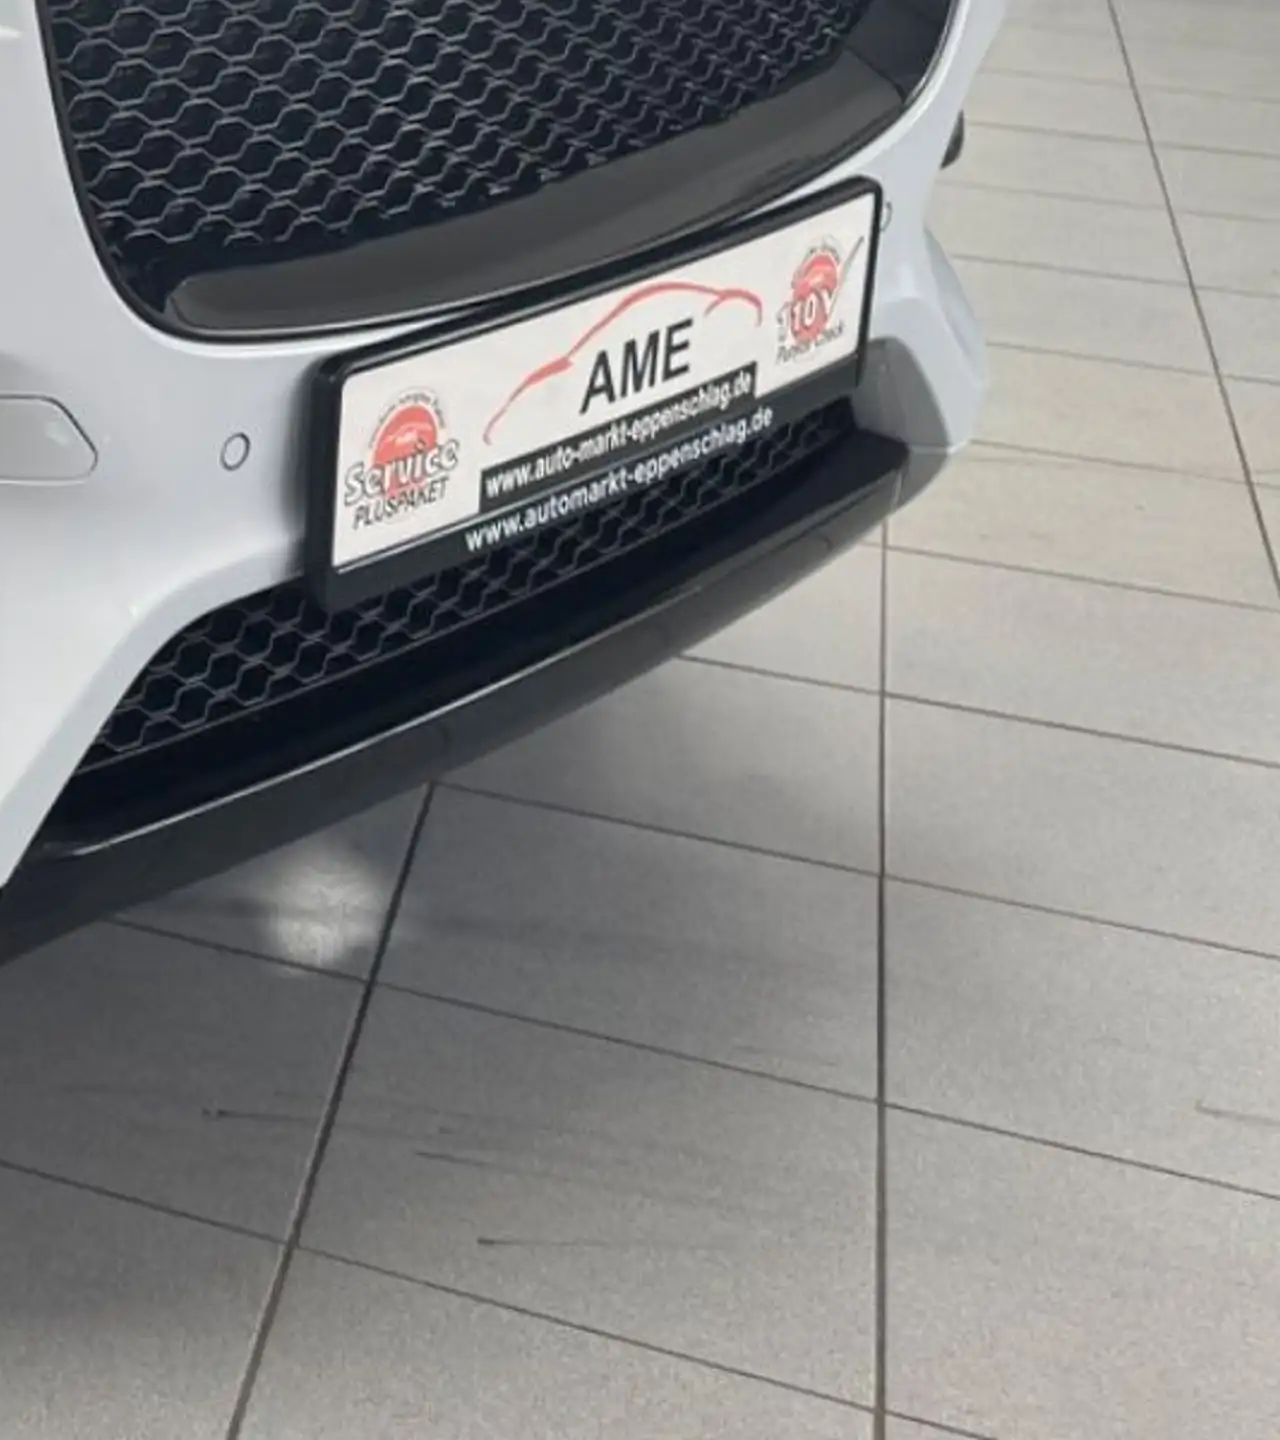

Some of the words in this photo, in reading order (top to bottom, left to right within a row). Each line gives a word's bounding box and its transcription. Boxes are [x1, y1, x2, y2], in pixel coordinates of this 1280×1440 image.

[579, 317, 694, 416] AME
[464, 405, 774, 552] www.automarkt-eppenschlag.de
[485, 370, 753, 498] www.auto-markt-eppenschlag.de
